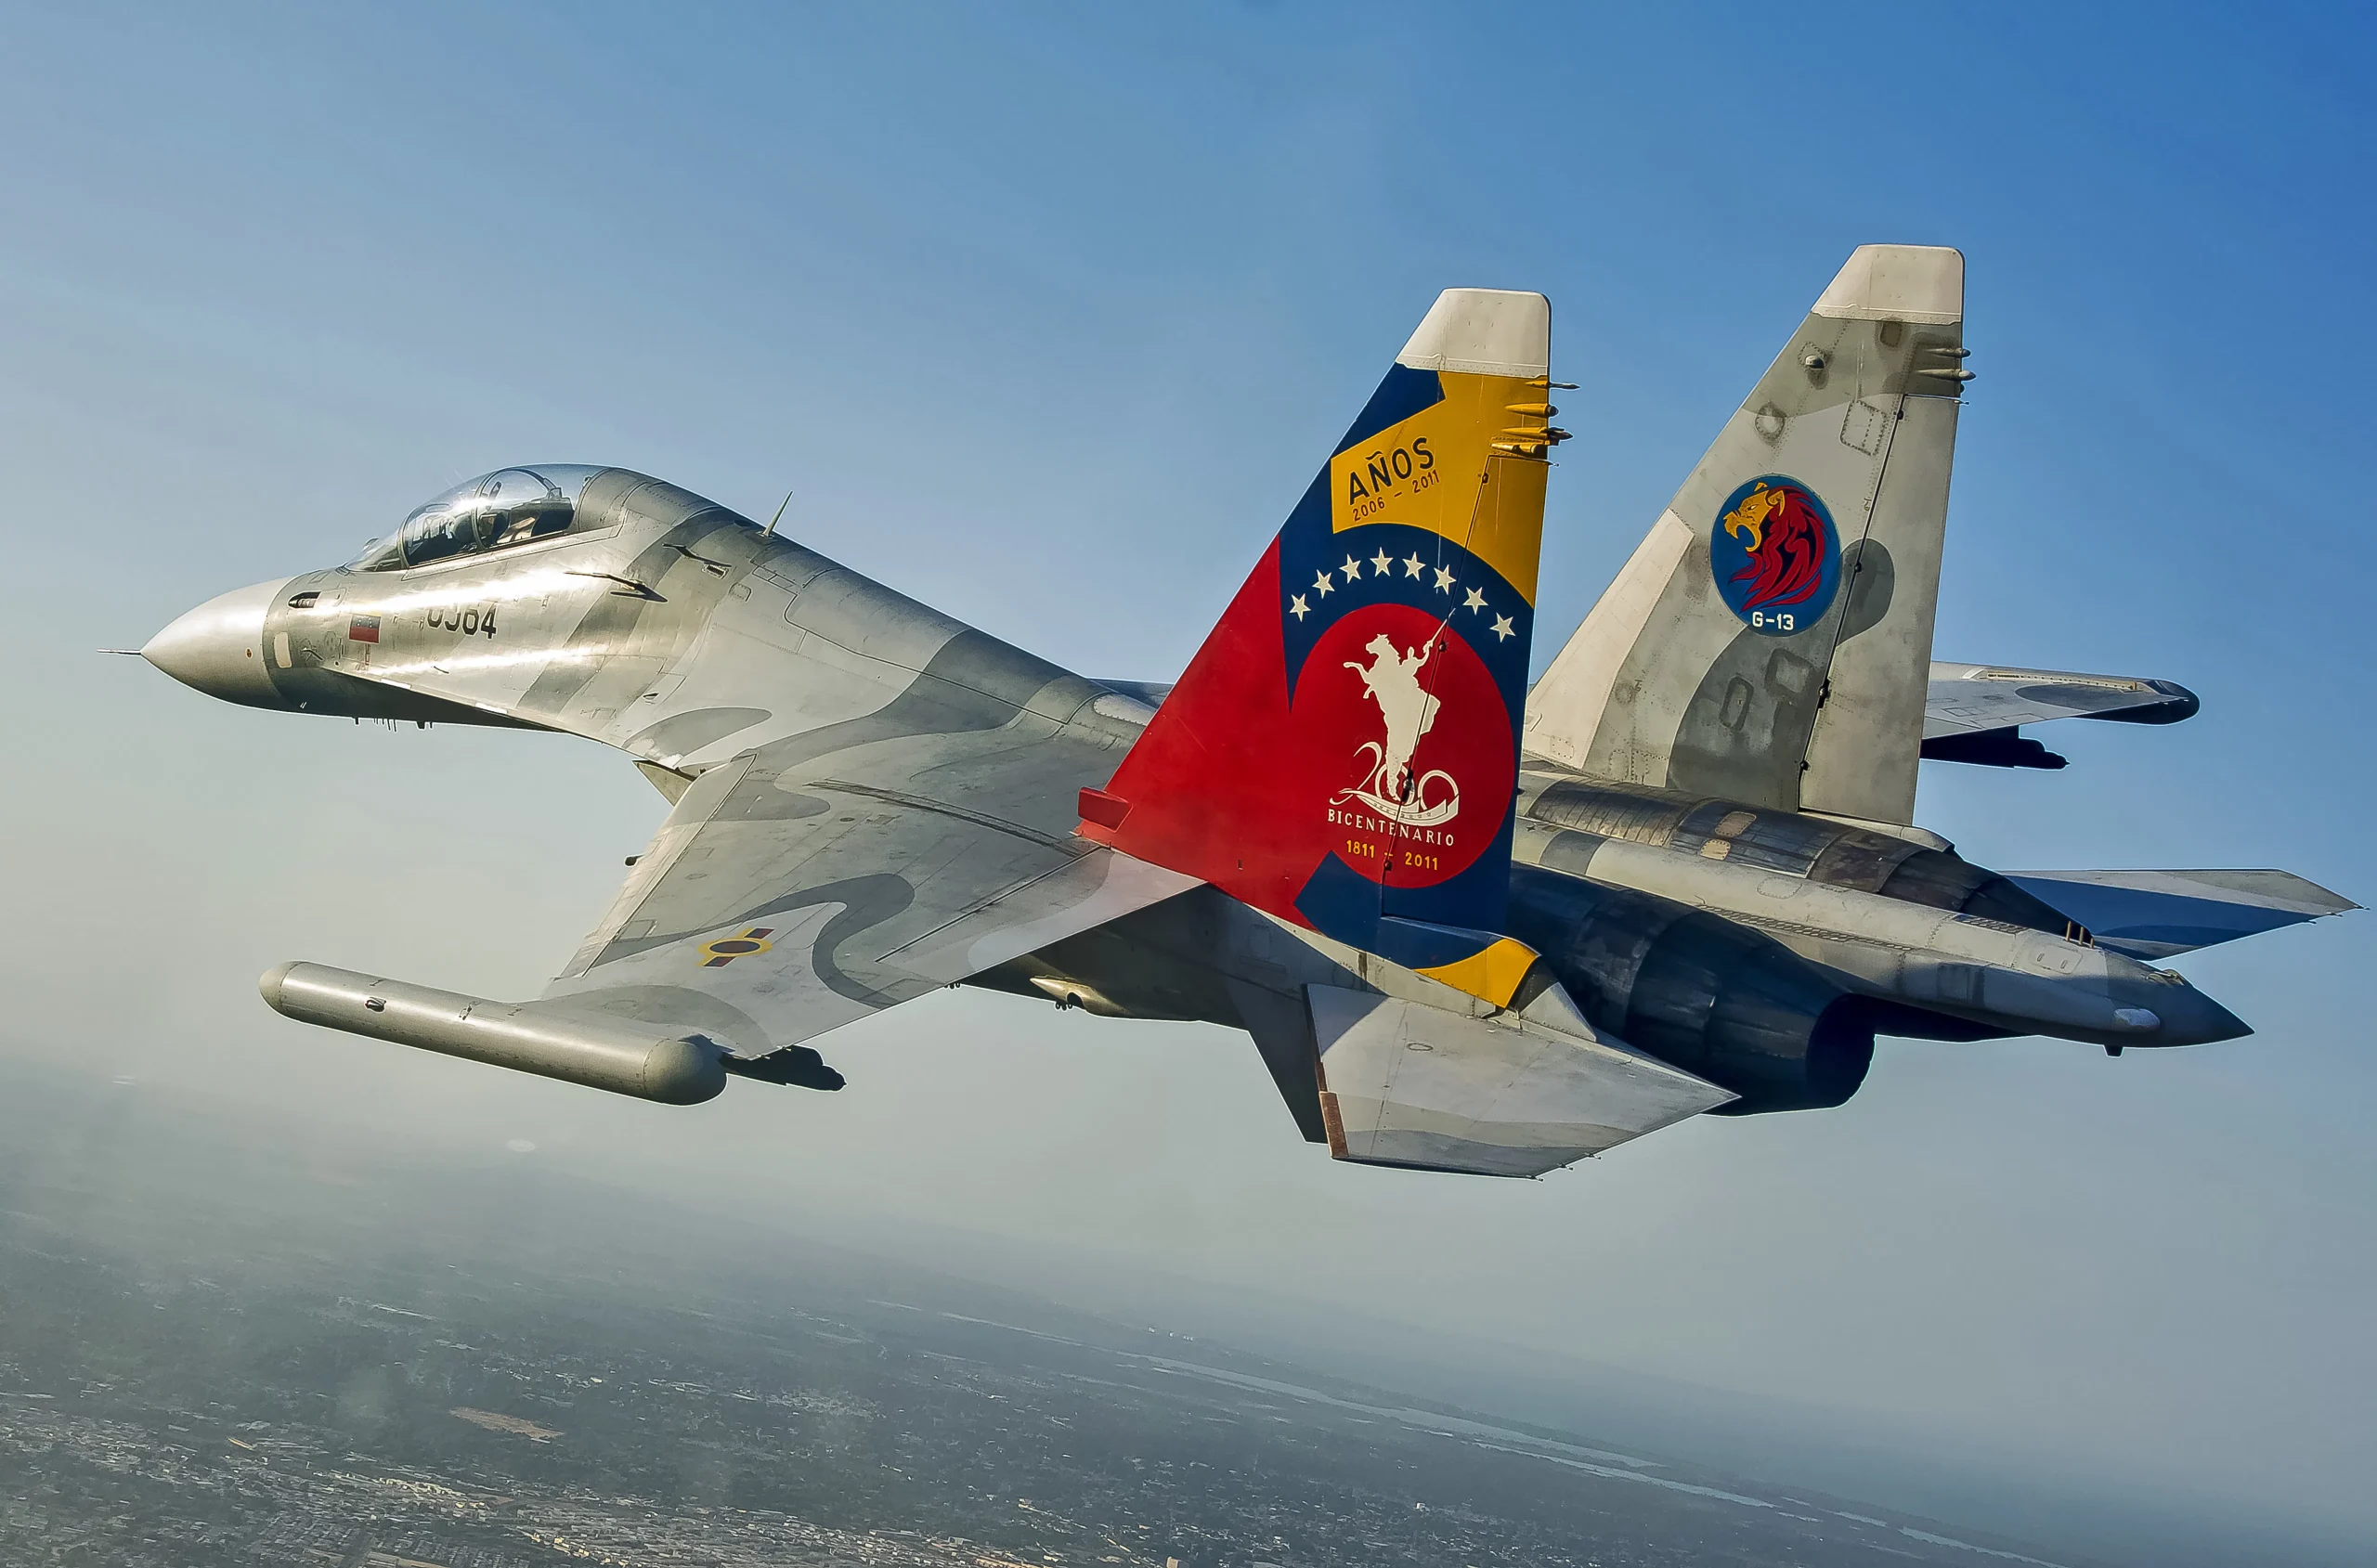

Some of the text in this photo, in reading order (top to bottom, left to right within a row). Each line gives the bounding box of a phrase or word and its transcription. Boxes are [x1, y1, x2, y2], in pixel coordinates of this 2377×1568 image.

[1349, 436, 1435, 506] AÑOS
[1352, 496, 1385, 522] 2006
[1411, 469, 1440, 495] 2011
[1751, 611, 1794, 631] G-13
[1327, 808, 1455, 847] BICENTENARIO
[1345, 839, 1375, 859] 1811
[1404, 851, 1438, 871] 2011
